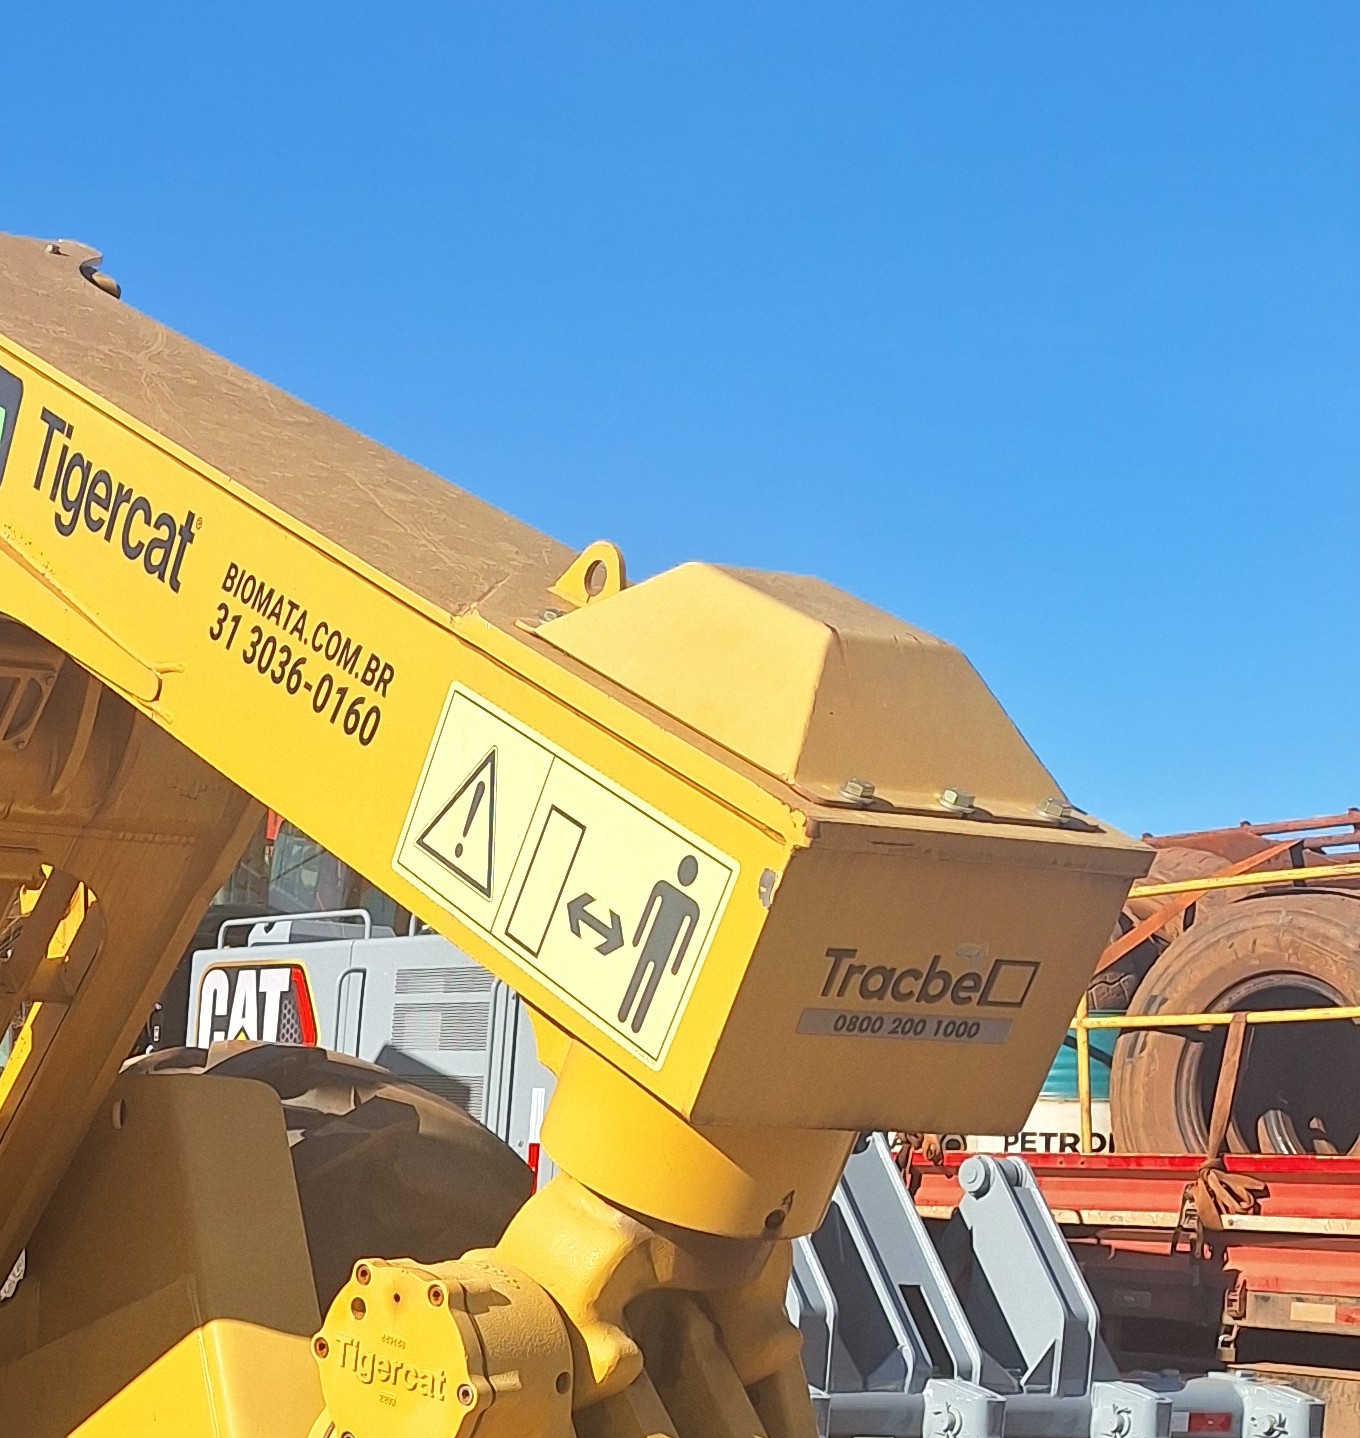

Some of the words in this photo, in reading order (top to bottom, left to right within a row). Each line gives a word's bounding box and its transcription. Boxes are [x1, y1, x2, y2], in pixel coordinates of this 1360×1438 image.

[221, 561, 395, 698] BIOMATA.COM.BR
[209, 602, 243, 650] 31
[242, 624, 381, 747] 3036-0160
[198, 967, 291, 1049] CAT
[833, 1014, 885, 1034] 0800
[888, 1017, 927, 1037] 200
[932, 1020, 981, 1039] 1000
[335, 1333, 447, 1402] Tigercat
